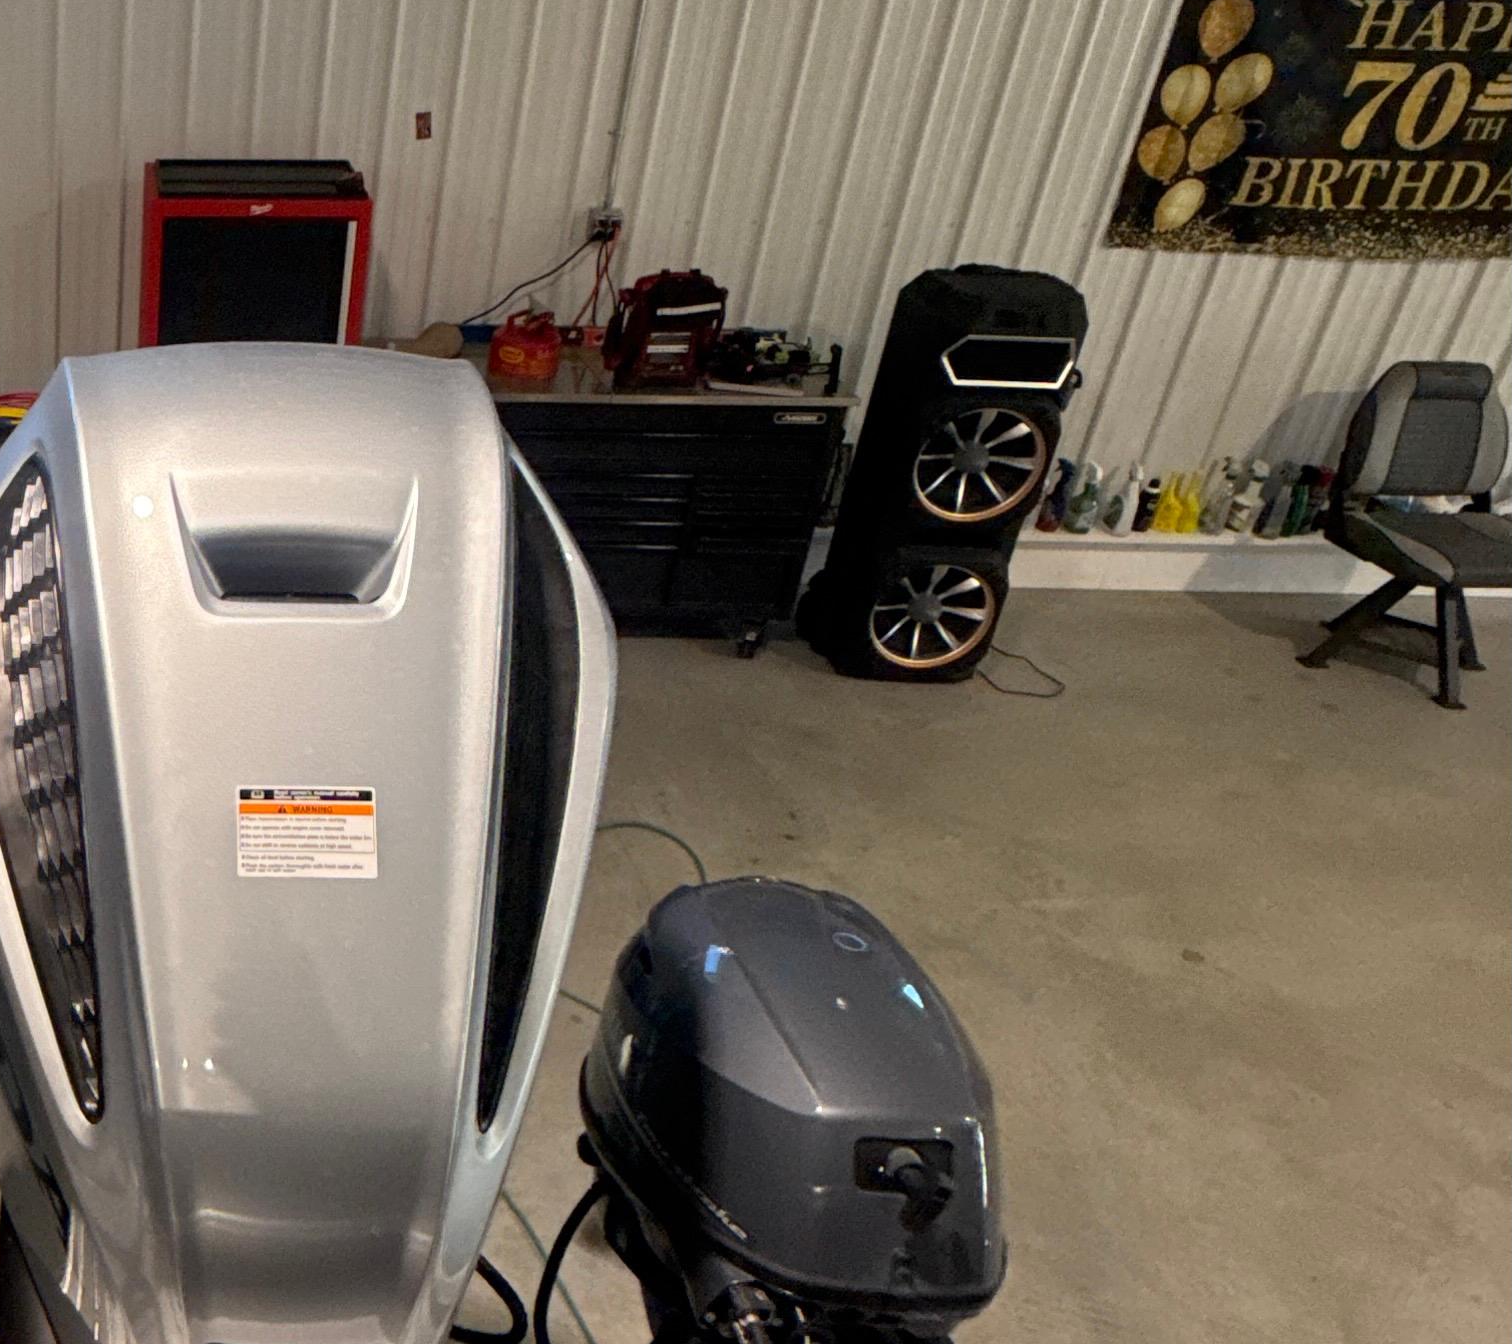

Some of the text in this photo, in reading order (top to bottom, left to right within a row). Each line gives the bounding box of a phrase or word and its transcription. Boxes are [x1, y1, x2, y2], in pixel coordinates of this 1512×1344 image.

[1340, 60, 1507, 152] 70 TH
[292, 804, 334, 814] WARNING
